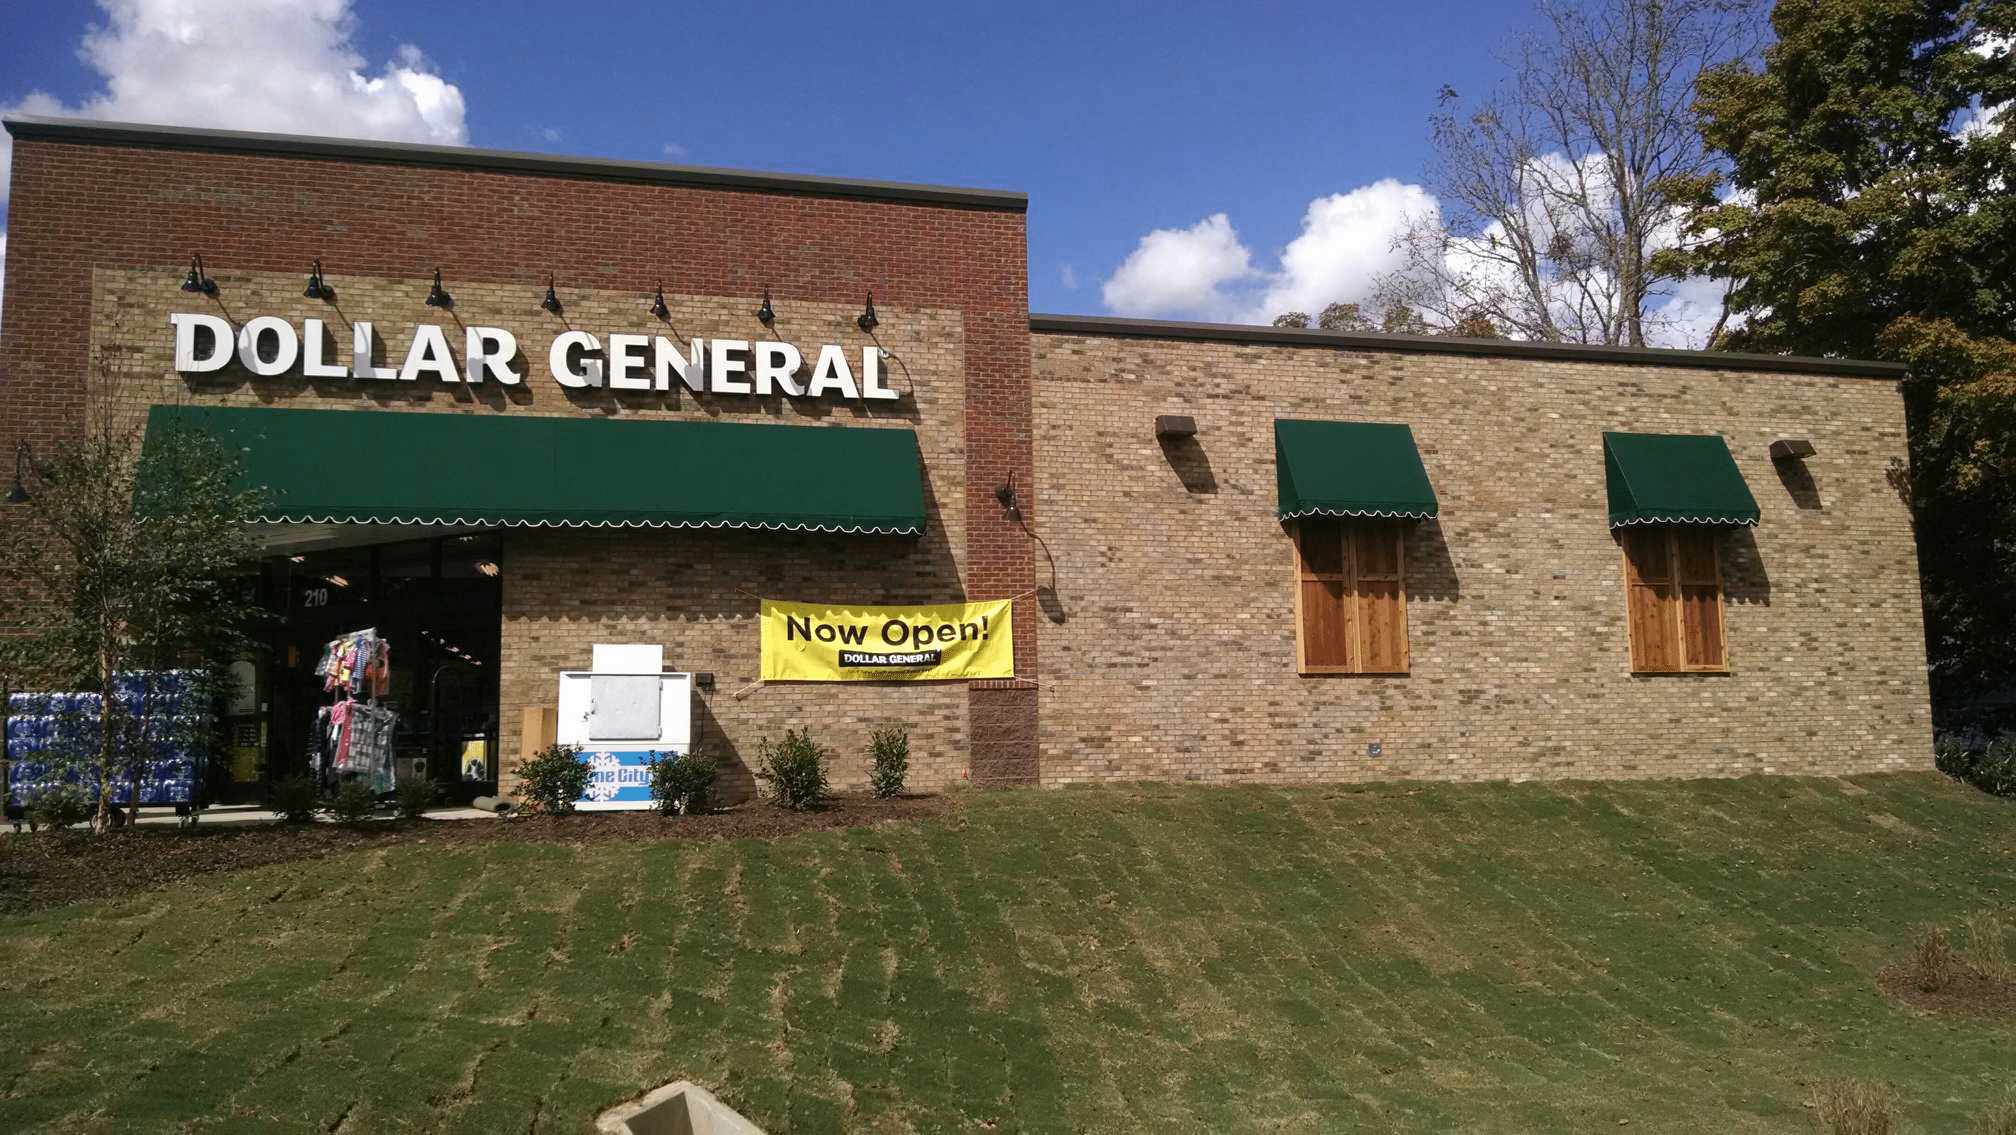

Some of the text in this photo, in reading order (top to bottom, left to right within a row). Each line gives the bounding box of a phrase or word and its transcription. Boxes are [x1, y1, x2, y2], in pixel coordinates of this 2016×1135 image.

[171, 313, 900, 399] DOLLAR GENERAL
[304, 588, 328, 607] 210
[787, 616, 989, 649] Now Open!
[844, 653, 937, 664] DOLLAR GENERAL
[618, 768, 651, 785] City
